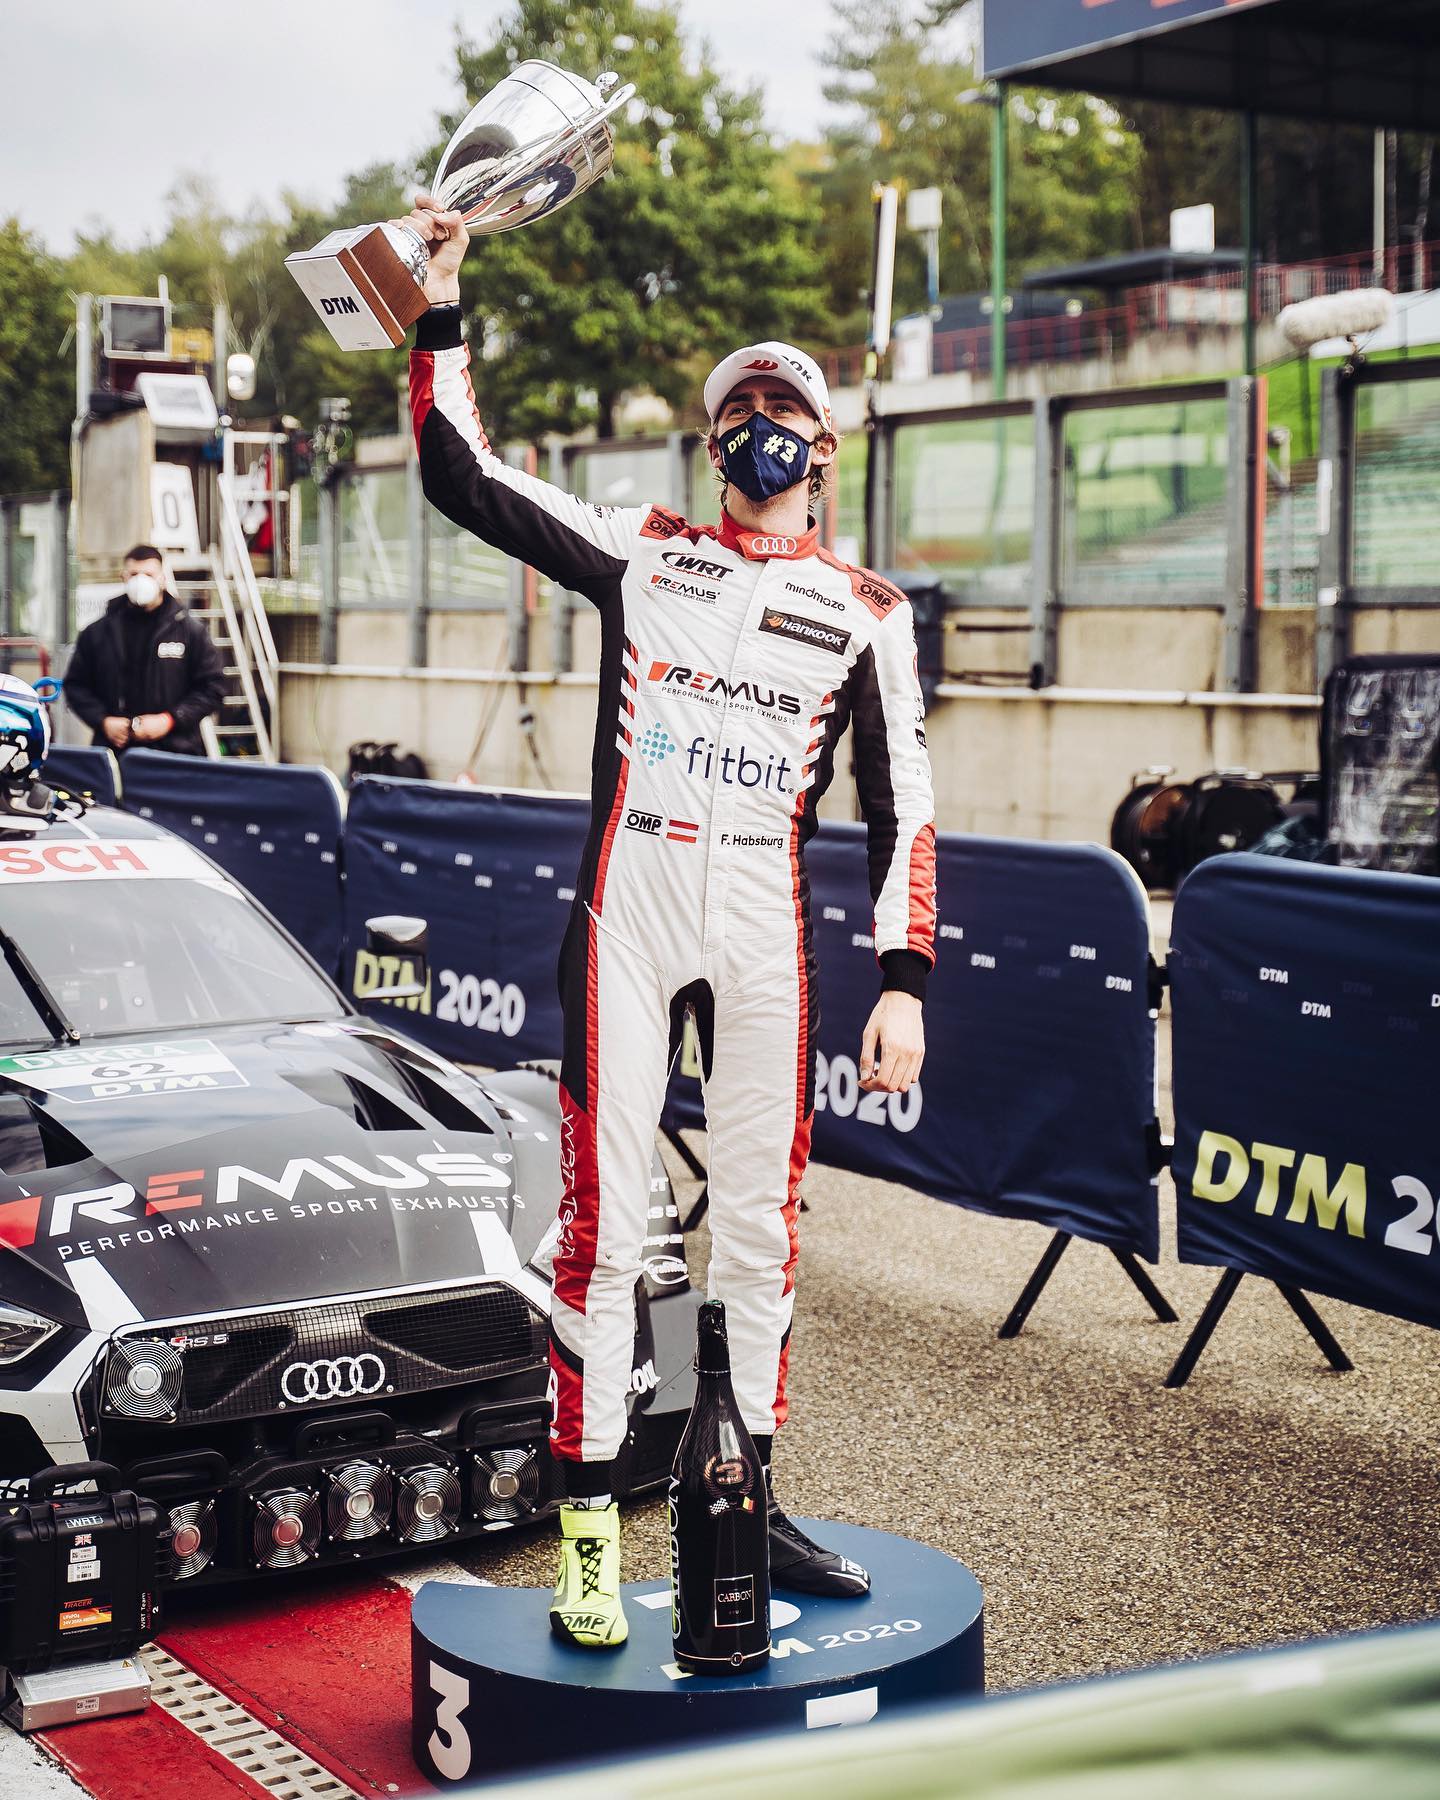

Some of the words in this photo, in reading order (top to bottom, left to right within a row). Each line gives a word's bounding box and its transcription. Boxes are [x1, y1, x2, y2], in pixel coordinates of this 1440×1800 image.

[320, 296, 360, 315] DTM
[728, 428, 751, 454] DTM
[762, 434, 799, 464] #3
[673, 556, 734, 579] WRT
[658, 577, 717, 600] REMUS
[785, 582, 846, 612] mindmaze
[860, 584, 892, 607] OMP
[664, 666, 801, 715] REMUS
[661, 686, 720, 707] PERFORMANCE
[729, 701, 754, 713] SPORT
[757, 709, 796, 726] EXHAUSTS
[687, 737, 792, 793] fitbit
[627, 812, 662, 832] OMP
[721, 834, 731, 846] F.
[733, 835, 784, 849] Habsburg
[823, 907, 846, 922] DTM
[940, 925, 963, 940] DTM
[971, 953, 996, 969] DTM
[1070, 945, 1096, 961] DTM
[1106, 976, 1132, 992] DTM
[1260, 967, 1288, 984] DTM
[435, 969, 526, 1037] 2020
[1301, 1001, 1331, 1018] DTM
[12, 1045, 188, 1071] DEKRA
[91, 1063, 175, 1079] 62
[92, 1074, 219, 1097] DTM
[49, 1152, 513, 1237] REMUS
[1192, 1130, 1366, 1238] DTM
[1384, 1175, 1440, 1256] 2
[57, 1207, 279, 1260] PERFORMANCE
[293, 1197, 378, 1219] SPORT
[394, 1194, 526, 1211] EXHAUSTS
[69, 1515, 98, 1528] WRT
[717, 1589, 752, 1604] CARBON
[152, 1606, 159, 1614] 2
[562, 1614, 607, 1631] OMP
[817, 1619, 922, 1649] 2020
[427, 1660, 472, 1780] 3
